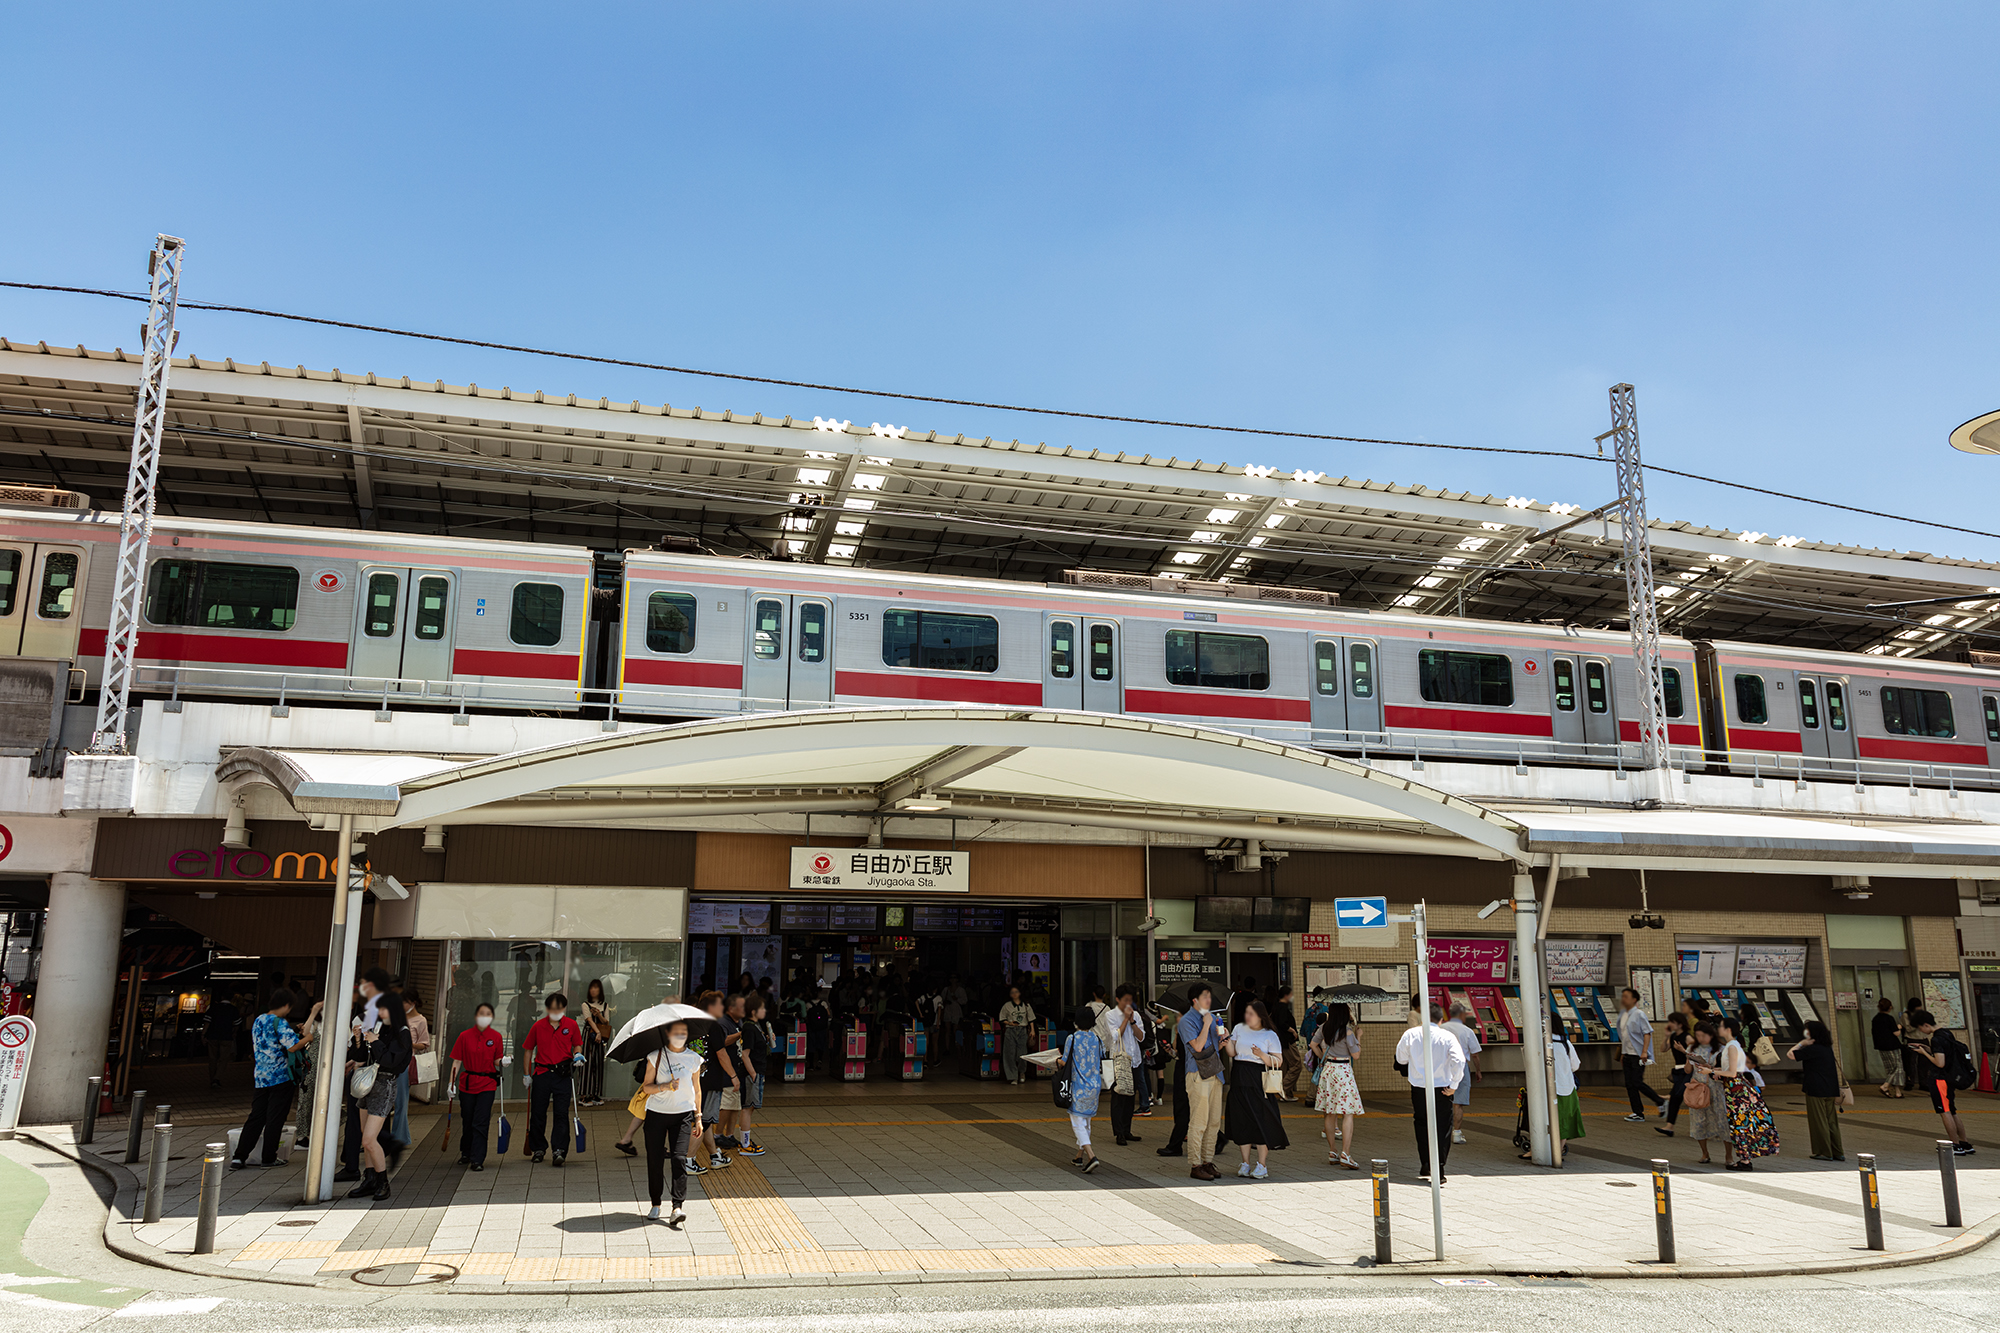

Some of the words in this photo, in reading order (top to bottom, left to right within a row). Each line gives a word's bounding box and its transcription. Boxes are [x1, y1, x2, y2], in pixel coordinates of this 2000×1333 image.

[719, 602, 726, 611] 3
[849, 612, 869, 621] 5351
[1858, 689, 1872, 697] 5451
[851, 853, 953, 876] 自由が丘駅
[803, 875, 841, 885] 東急電鉄
[918, 877, 936, 887] Sta.
[1426, 944, 1505, 959] カードチャージ
[1160, 963, 1200, 973] 自由が丘駅
[1428, 961, 1460, 971] Recharge
[1461, 961, 1470, 969] IC
[1471, 961, 1488, 970] Card
[12, 1050, 26, 1080] 駐輪禁止
